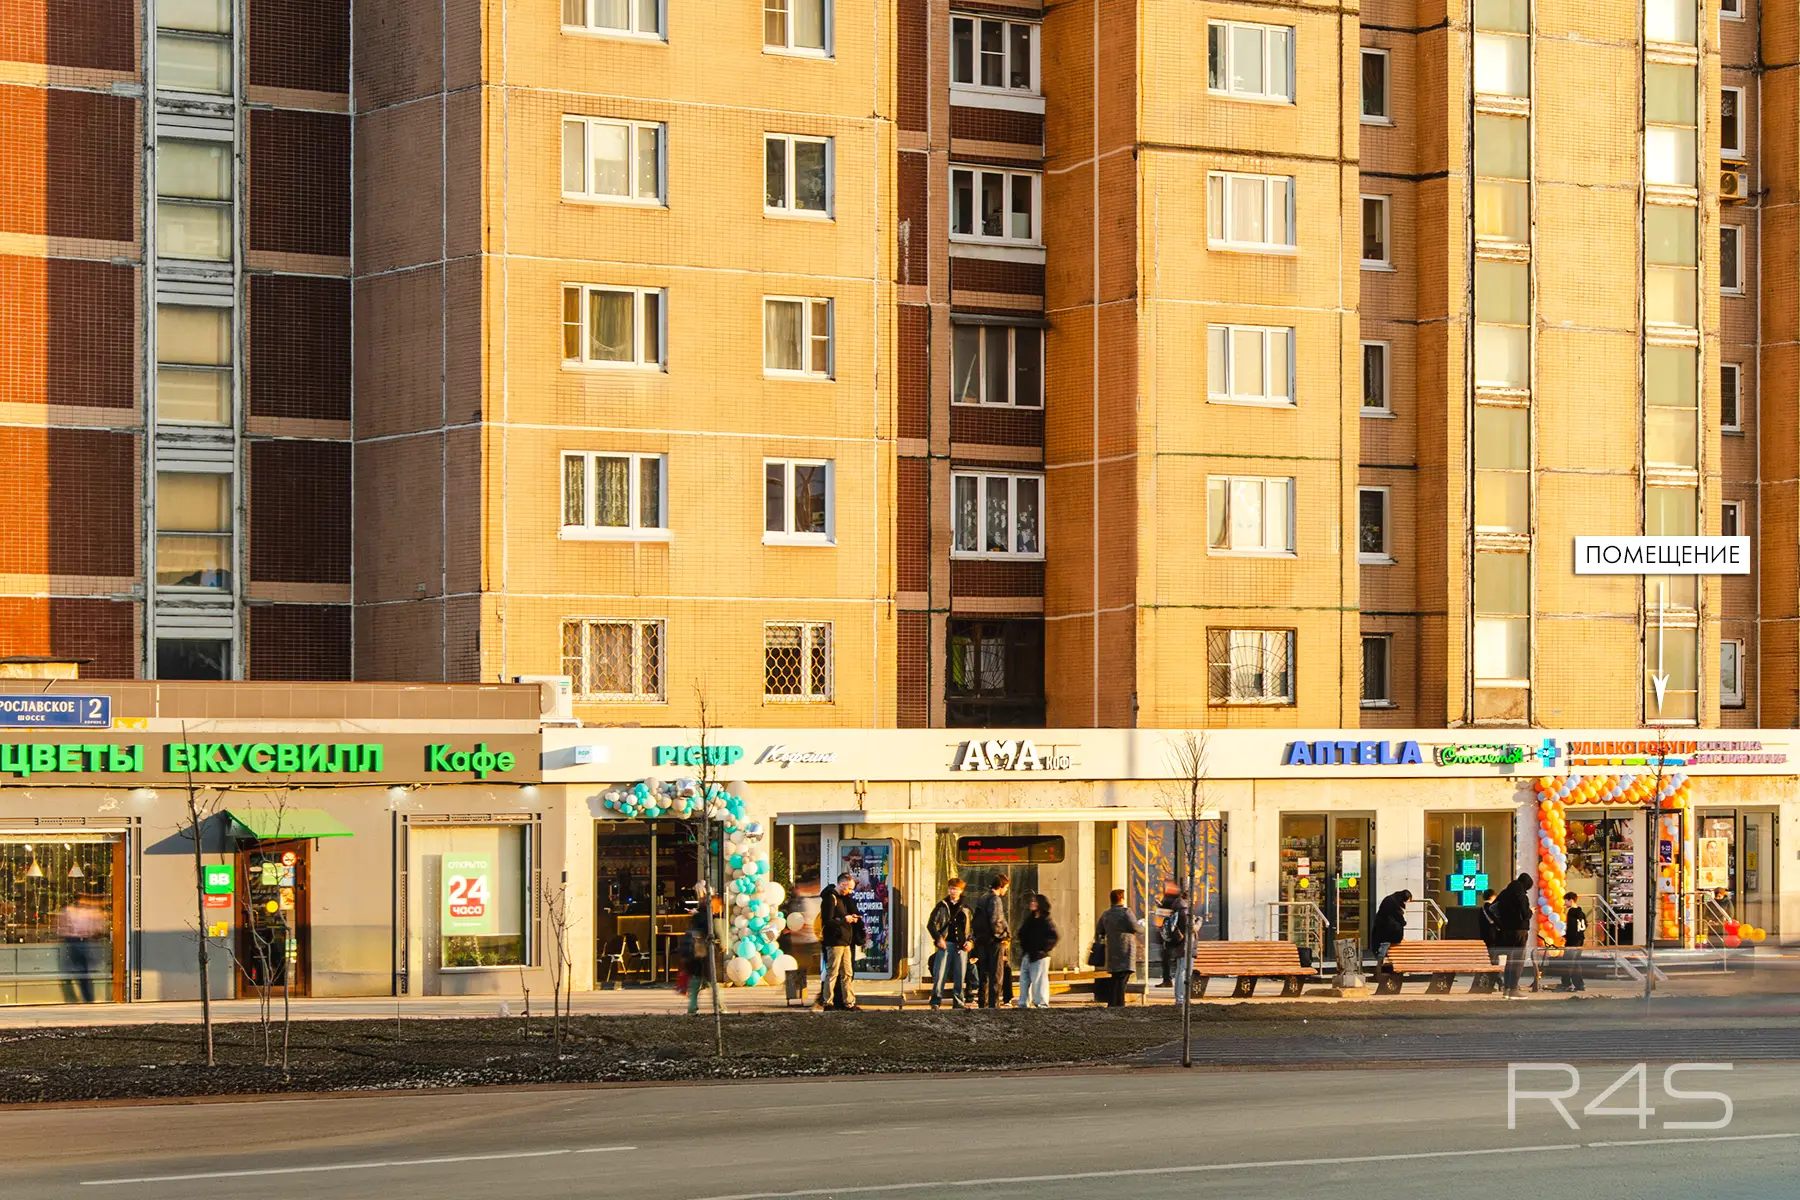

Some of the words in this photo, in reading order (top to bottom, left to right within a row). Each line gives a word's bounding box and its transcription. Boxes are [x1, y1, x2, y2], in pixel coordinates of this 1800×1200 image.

[88, 698, 102, 718] 2
[1, 744, 145, 777] ЦВЕТЫ
[168, 743, 384, 772] ВКУСВИЛЛ
[428, 742, 516, 779] Кафе
[657, 745, 744, 766] PICUP
[448, 861, 487, 869] ОТКРЫТО
[209, 873, 230, 886] ВВ
[1463, 877, 1476, 889] 24
[448, 875, 489, 905] 24
[453, 906, 482, 914] часа
